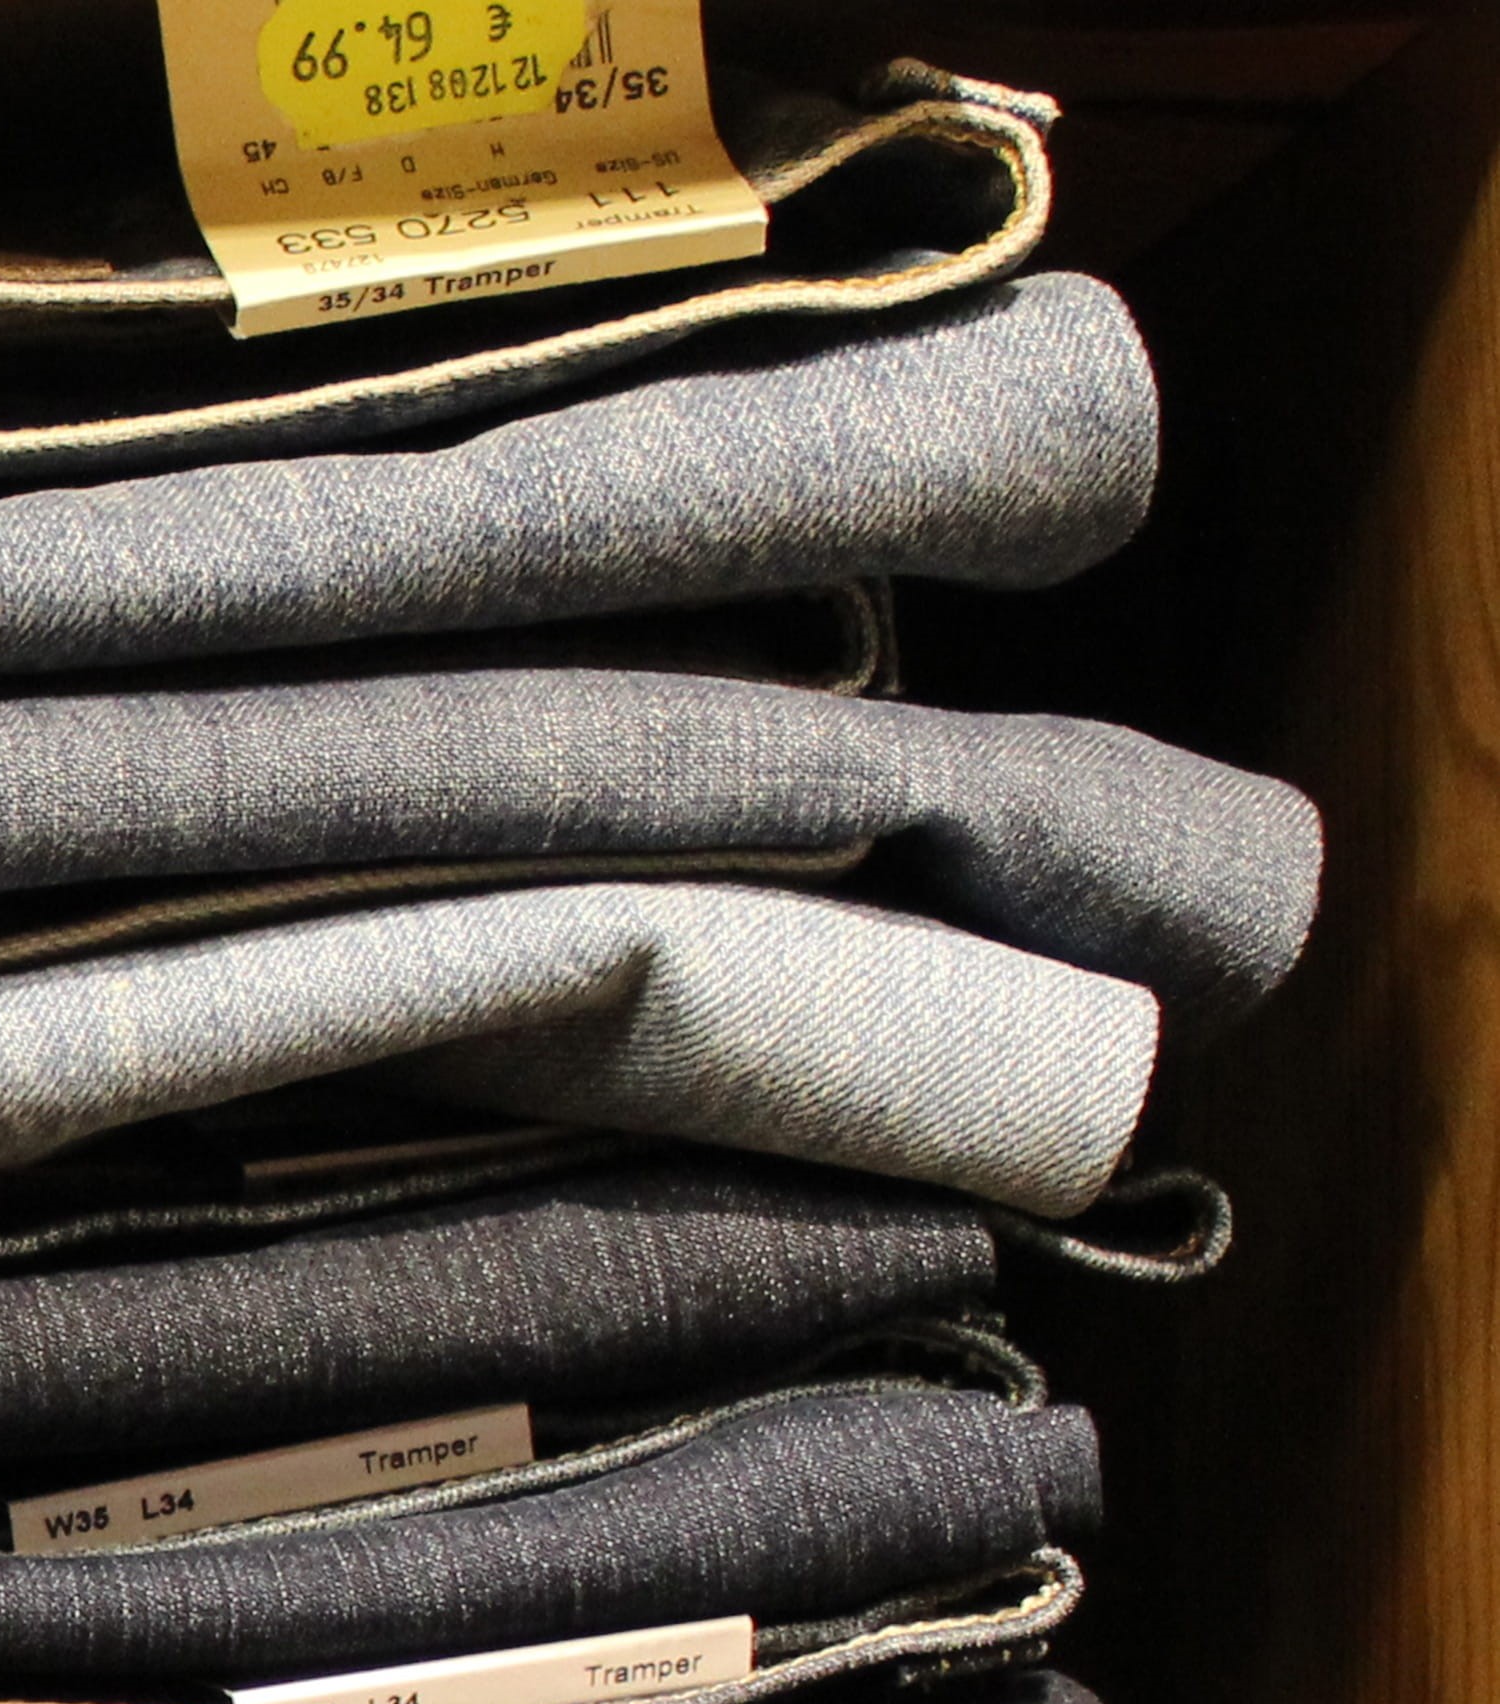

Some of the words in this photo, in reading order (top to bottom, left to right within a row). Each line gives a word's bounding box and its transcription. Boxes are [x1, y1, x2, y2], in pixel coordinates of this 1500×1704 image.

[487, 5, 512, 42] €
[293, 12, 432, 82] 64.99
[555, 67, 668, 114] 35/34
[242, 139, 277, 163] 45
[401, 156, 416, 173] D
[595, 150, 679, 175] US-Size
[260, 177, 289, 196] CH
[421, 169, 557, 200] German-Size
[396, 204, 530, 240] 5270
[574, 204, 703, 230] Tramper
[277, 224, 376, 255] 533
[317, 281, 405, 314] 35/34
[425, 257, 556, 297] Tramper
[44, 1505, 110, 1540] W35
[141, 1487, 194, 1521] L34
[358, 1431, 478, 1476] Tramper
[584, 1651, 704, 1691] Tramper
